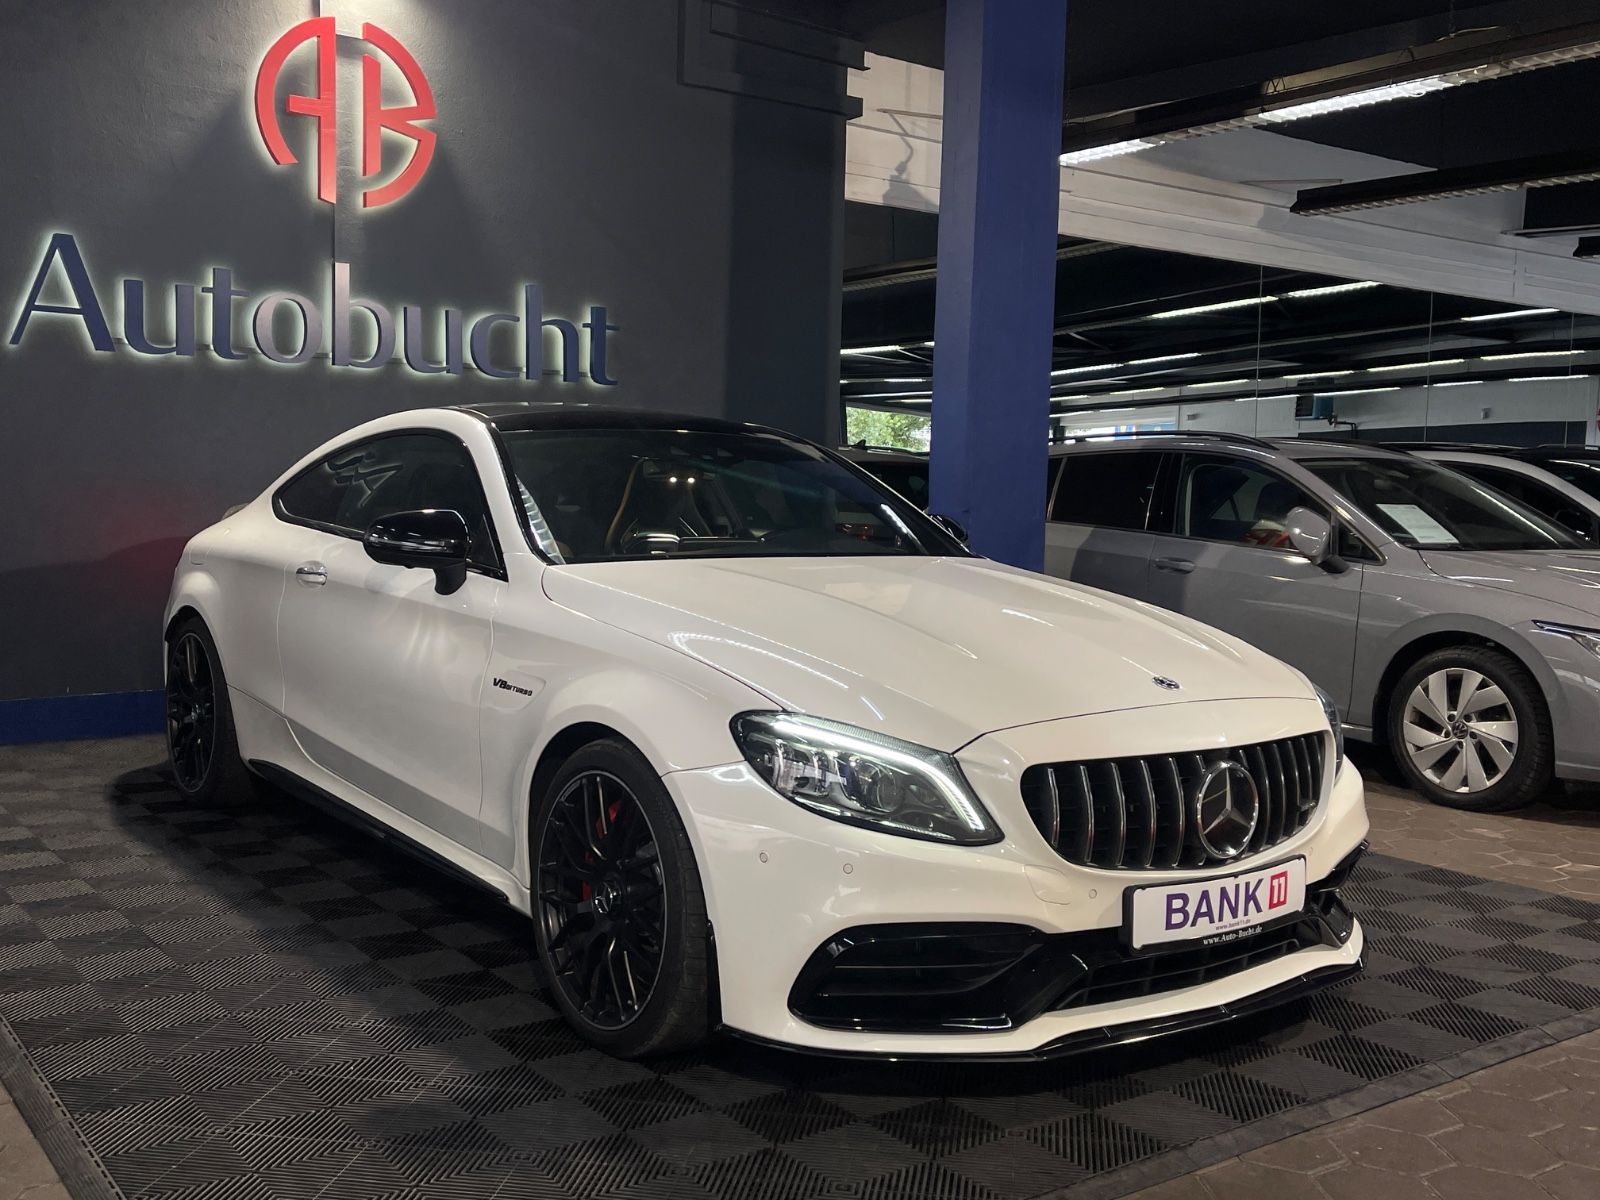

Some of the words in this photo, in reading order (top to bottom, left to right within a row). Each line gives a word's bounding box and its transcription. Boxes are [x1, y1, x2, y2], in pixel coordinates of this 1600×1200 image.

[10, 233, 620, 385] Autobucht
[1165, 878, 1264, 930] BANK
[1271, 873, 1288, 906] 11
[1203, 925, 1263, 945] www.Auto-Bucht.de
